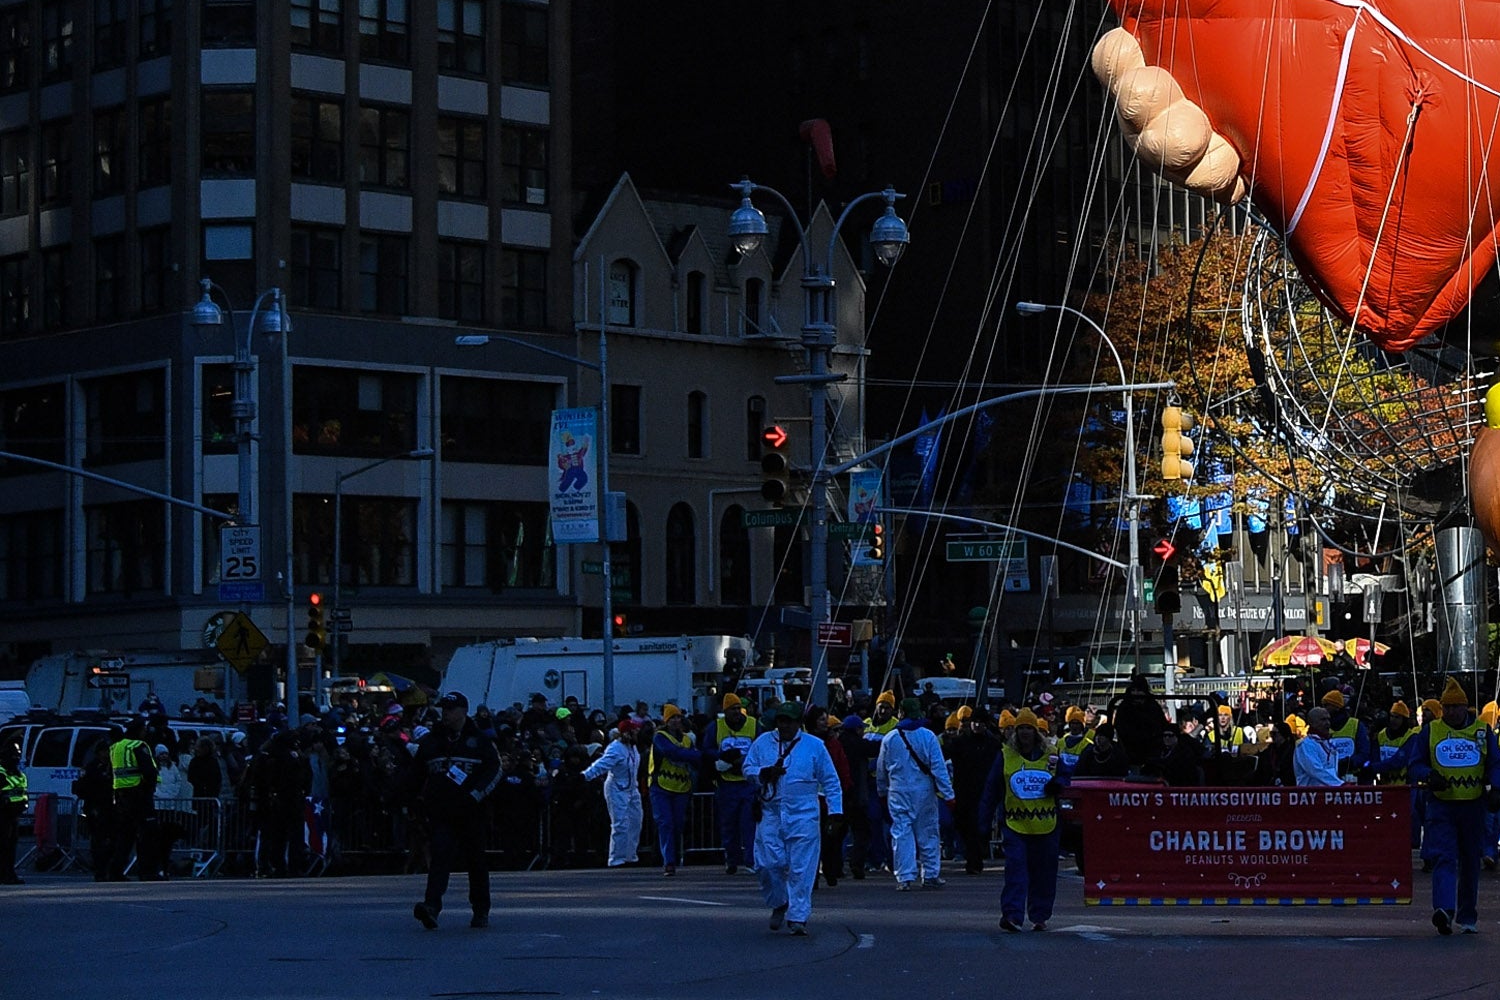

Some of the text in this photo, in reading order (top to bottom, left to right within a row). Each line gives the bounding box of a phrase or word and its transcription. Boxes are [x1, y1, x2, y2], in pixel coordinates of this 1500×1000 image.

[744, 512, 793, 526] Columbus
[232, 528, 249, 537] CITY
[229, 538, 254, 546] SPEED
[231, 546, 251, 555] LIMIT
[963, 545, 974, 557] W
[978, 545, 993, 557] 60
[226, 556, 257, 578] 25
[639, 642, 678, 650] sanitation
[1454, 744, 1474, 752] GOOD
[1109, 791, 1383, 807] MACY'S THANKSGIVING DAY PARADE
[1226, 813, 1263, 824] presents
[1150, 829, 1345, 852] CHARLIE BROWN
[1185, 854, 1309, 866] PEANUTS WORLDWIDE
